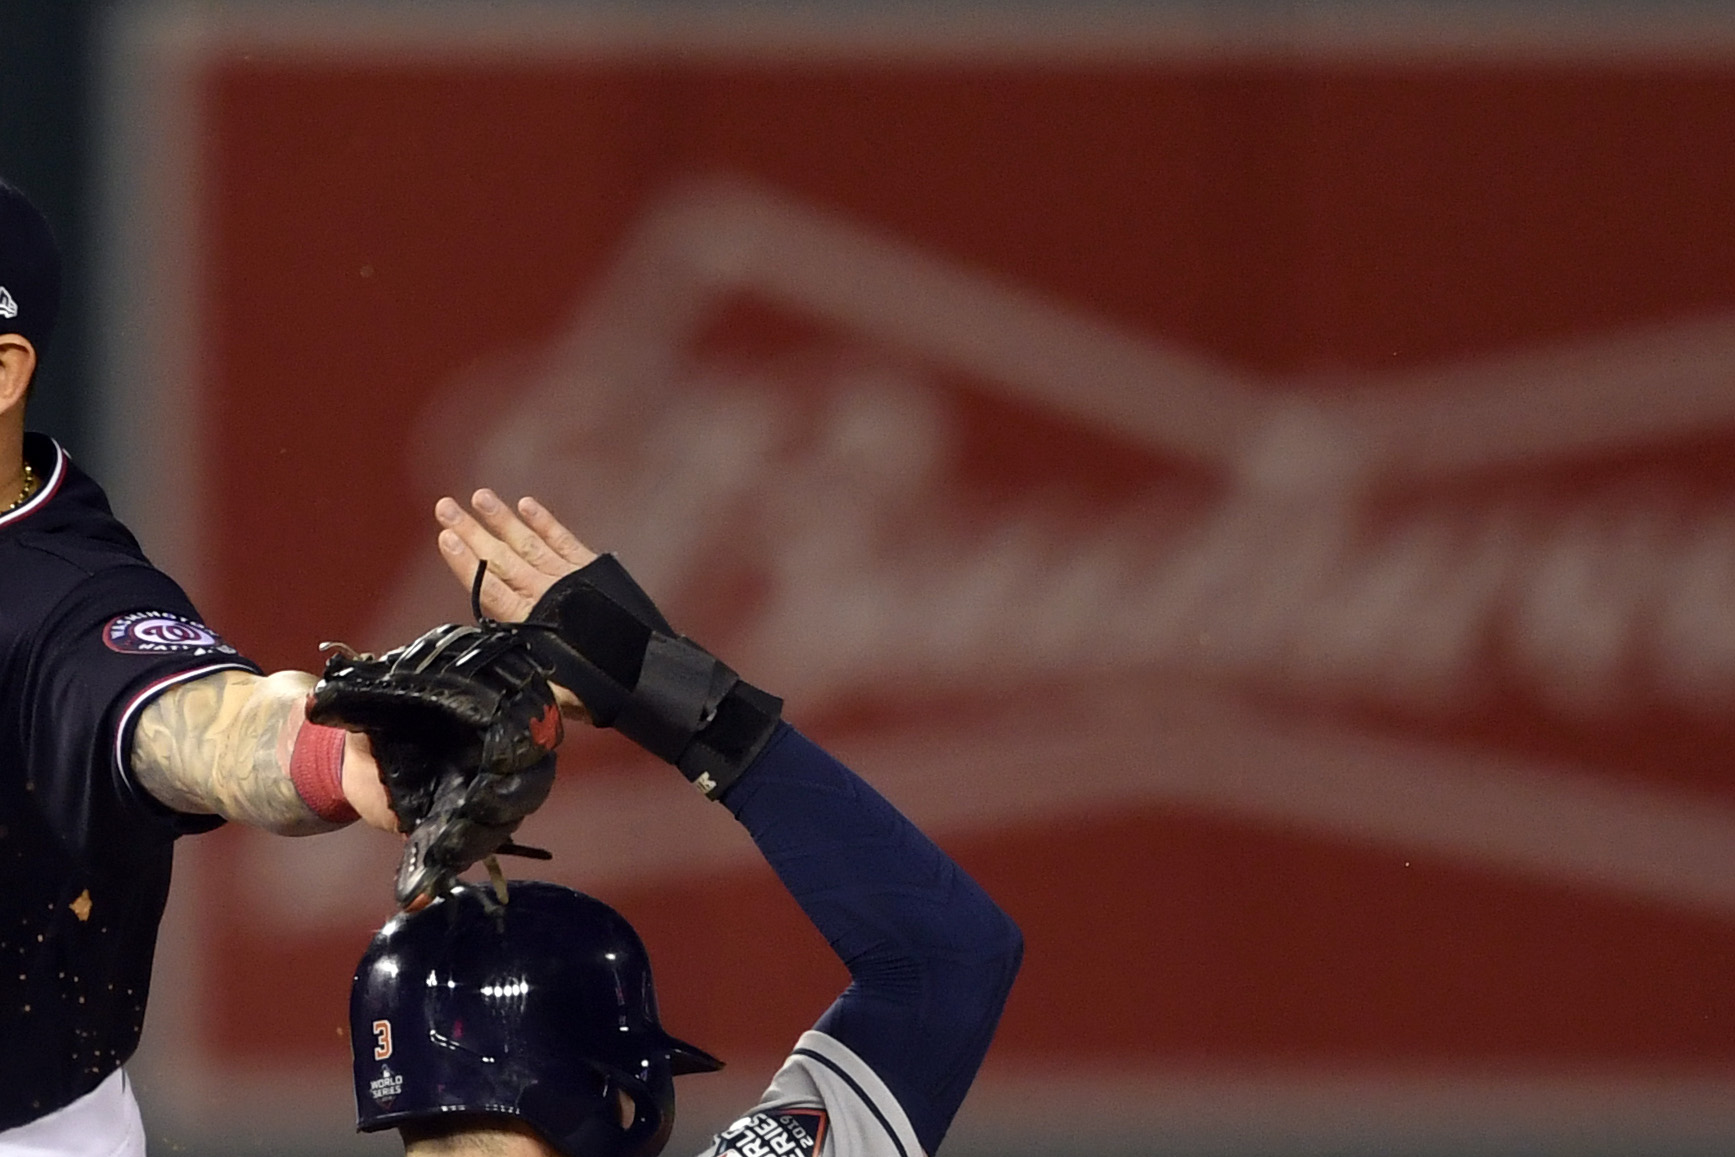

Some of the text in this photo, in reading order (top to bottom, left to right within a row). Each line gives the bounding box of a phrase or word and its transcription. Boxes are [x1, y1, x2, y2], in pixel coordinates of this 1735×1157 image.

[373, 1019, 393, 1061] 3
[370, 1075, 403, 1090] WORLD
[780, 1114, 814, 1149] 2019
